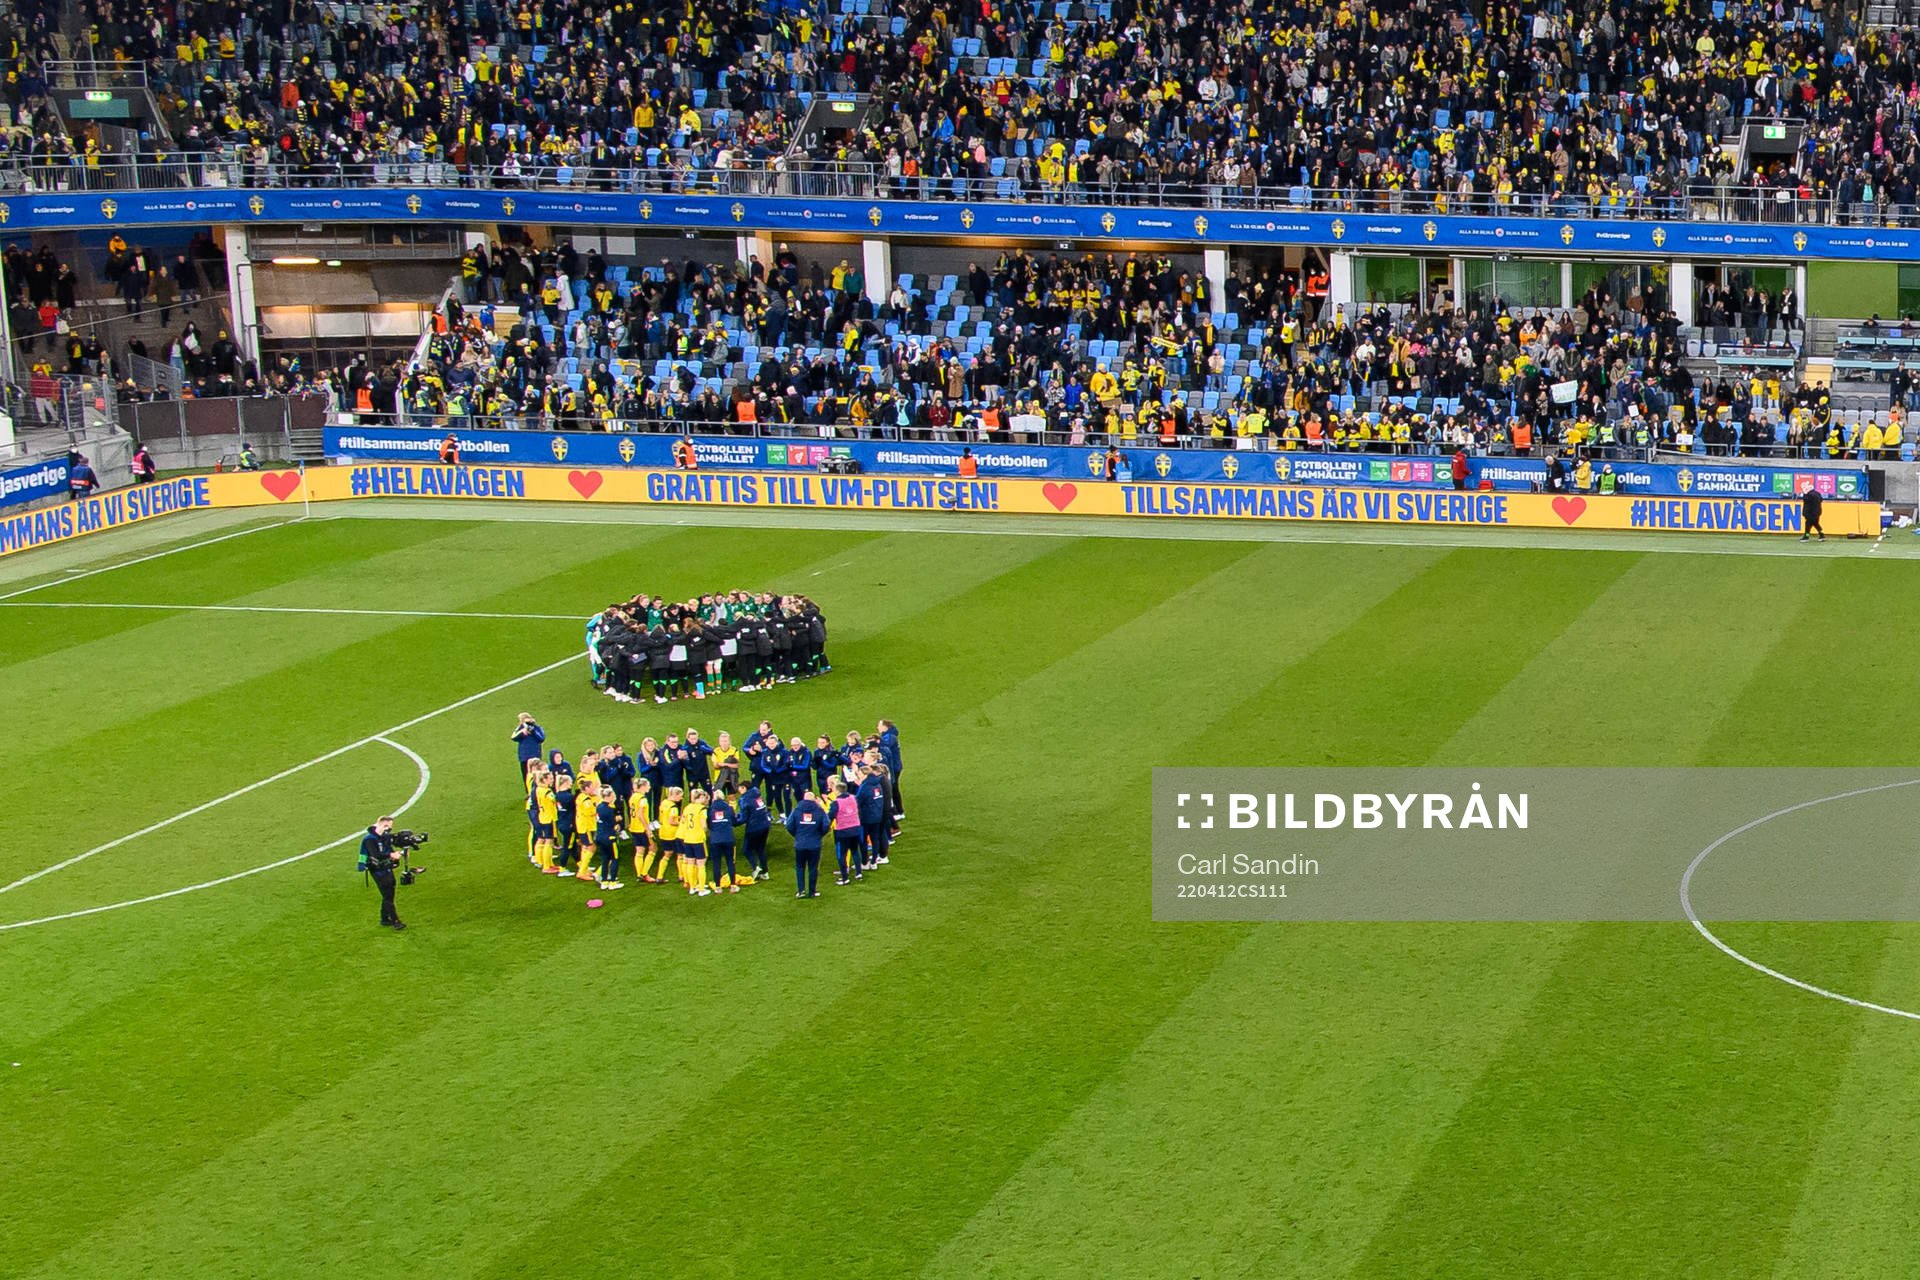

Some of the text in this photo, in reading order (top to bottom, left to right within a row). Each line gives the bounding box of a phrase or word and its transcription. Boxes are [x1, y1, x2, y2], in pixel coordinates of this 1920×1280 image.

[805, 132, 818, 149] L2
[1295, 461, 1356, 471] FOTBOLLEN
[1295, 469, 1358, 480] SAMHÄLLET
[1697, 473, 1759, 483] FOTBOLLEN
[351, 466, 525, 497] #HELAVÄGEN
[647, 473, 999, 510] GRATTIS TILL VM-PLATSEN!
[1697, 481, 1760, 492] SAMHÄLLET
[77, 500, 102, 533] ÄR
[104, 491, 125, 526] VI
[128, 477, 210, 521] SVERIGE
[1121, 486, 1508, 524] TILLSAMMANS ÄR VI SVERIGE
[1631, 499, 1801, 531] #HELAVÄGEN
